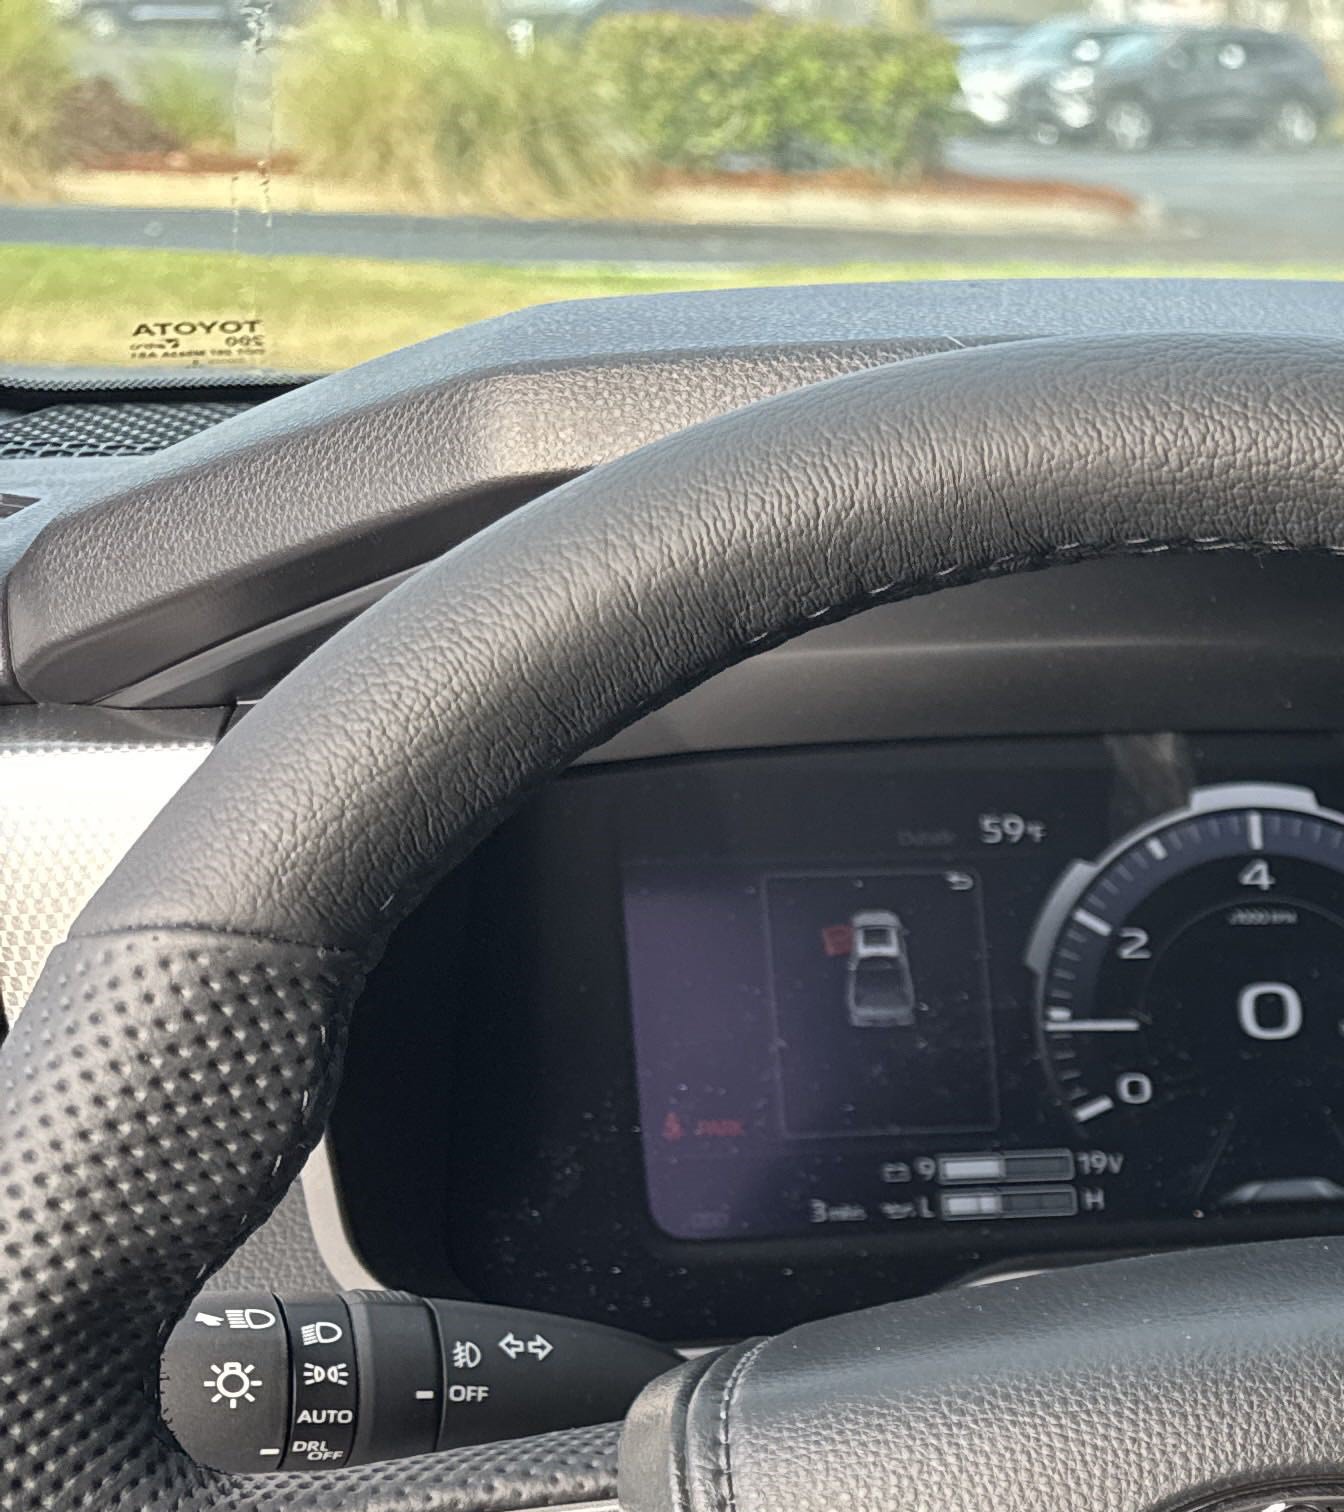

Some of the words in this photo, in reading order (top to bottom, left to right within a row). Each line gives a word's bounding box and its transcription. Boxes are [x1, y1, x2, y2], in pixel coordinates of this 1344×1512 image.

[1240, 860, 1275, 890] 4
[1117, 928, 1152, 959] 2
[1238, 981, 1302, 1040] 0
[1117, 1073, 1153, 1104] 0
[448, 1384, 489, 1403] OFF
[296, 1408, 354, 1426] AUTO
[291, 1438, 330, 1453] DRL
[306, 1449, 345, 1463] OFF
